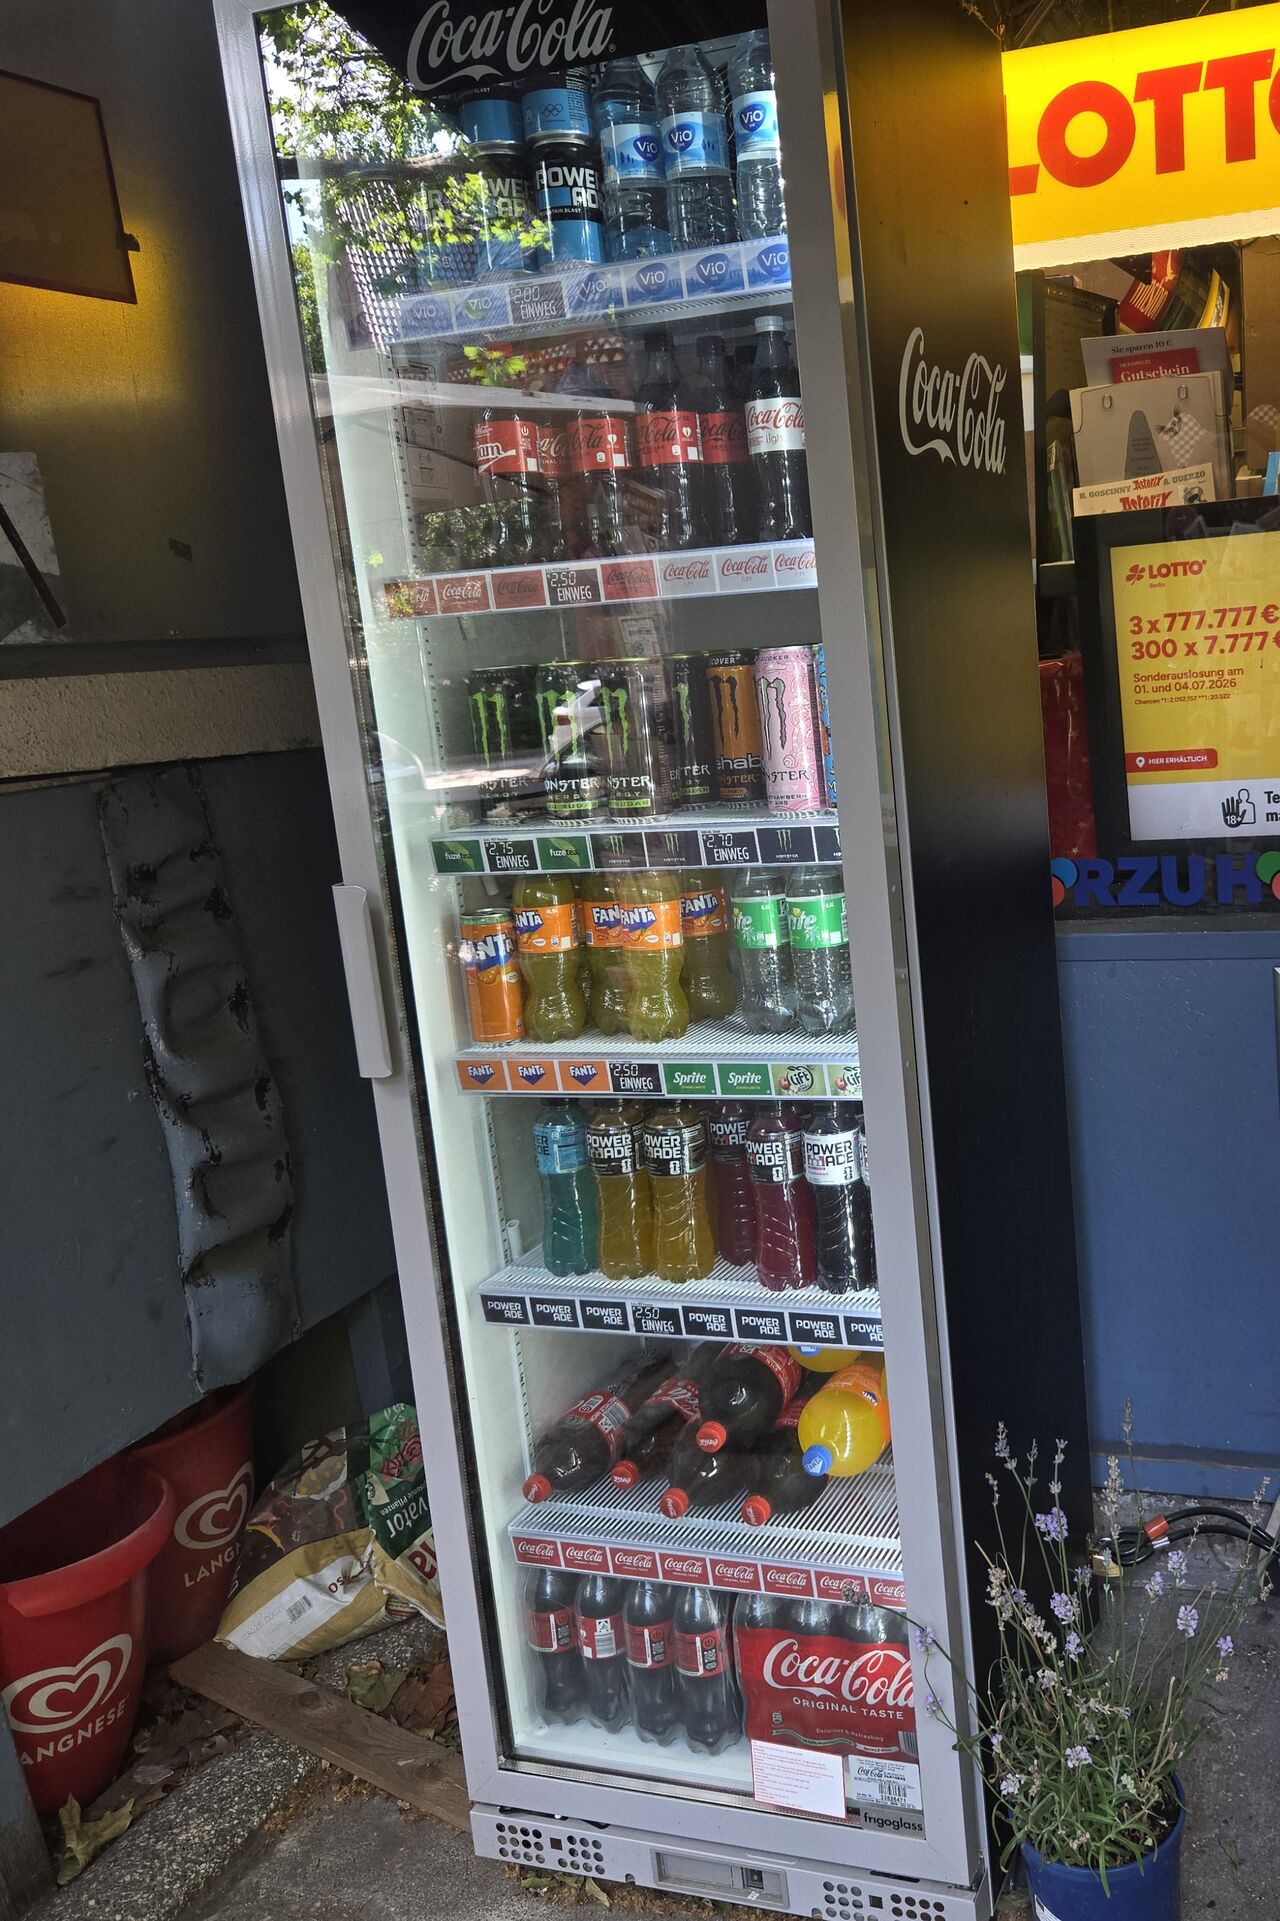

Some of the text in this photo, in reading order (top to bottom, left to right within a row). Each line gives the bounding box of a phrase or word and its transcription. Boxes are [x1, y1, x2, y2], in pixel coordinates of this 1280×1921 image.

[407, 0, 614, 91] Coca-Cola
[741, 110, 763, 124] ViO
[1004, 48, 1280, 196] OTT
[670, 130, 693, 144] ViO
[635, 140, 658, 154] ViO
[536, 166, 599, 191] POWE
[762, 252, 788, 267] ViO
[699, 261, 727, 276] ViO
[638, 270, 666, 286] ViO
[520, 301, 557, 320] EINWEG
[1120, 364, 1190, 383] Gutschein
[898, 326, 1008, 474] Coca-Cola
[766, 434, 786, 446] ligh
[1088, 485, 1132, 499] GOSCINNY
[1132, 475, 1165, 492] Asterix
[1172, 471, 1206, 484] UDERZO
[1119, 490, 1174, 512] Asterix
[721, 554, 771, 578] Coca-Cola
[774, 550, 816, 573] Coca-Col
[663, 559, 711, 582] Coca-Cola
[1148, 560, 1204, 580] LOTTO
[442, 579, 483, 601] Coca-Cola
[1149, 582, 1166, 590] Berlin
[557, 585, 592, 603] EINWEG
[1128, 603, 1280, 636] 3 x 777.777 €
[1130, 637, 1178, 661] 300
[1183, 641, 1199, 657] x
[1203, 630, 1270, 656] 7.777
[1133, 666, 1244, 684] Sonderauslosung am
[1133, 678, 1237, 695] 01. und 04.07.2026
[1134, 697, 1161, 706] Chancen
[1148, 754, 1208, 766] HIER ERHÄLTLICH
[1225, 814, 1242, 825] 18+
[496, 854, 530, 869] EINWEG
[714, 846, 750, 863] EINWEG
[621, 905, 657, 926] FANTA
[467, 1064, 496, 1076] FANTA
[517, 1064, 546, 1077] FANTA
[569, 1064, 598, 1077] FANTA
[620, 1076, 654, 1090] EINWEG
[673, 1071, 707, 1086] Sprite
[727, 1072, 763, 1087] Sprite
[710, 1121, 750, 1136] POWE
[586, 1134, 632, 1147] POWER
[806, 1140, 854, 1156] POWER
[603, 1147, 633, 1159] ADE
[652, 1147, 682, 1159] ADE
[756, 1154, 785, 1166] ADE
[824, 1151, 854, 1167] ADE
[487, 1300, 522, 1312] POWER
[536, 1303, 572, 1315] POWER
[586, 1306, 622, 1318] POWER
[504, 1310, 525, 1320] ADE
[553, 1312, 574, 1323] ADE
[603, 1315, 625, 1326] ADE
[688, 1312, 727, 1324] POWER
[741, 1315, 780, 1328] POWER
[642, 1319, 676, 1334] EINWEG
[706, 1322, 728, 1333] ADE
[759, 1326, 782, 1336] ADE
[795, 1319, 835, 1331] POWER
[814, 1329, 837, 1340] ADE
[861, 1390, 878, 1407] FANTA
[379, 1495, 409, 1517] Pflanzen
[518, 1541, 555, 1557] Coca-Cola
[566, 1546, 604, 1562] Coca-Cola
[615, 1552, 653, 1568] Coca-Cola
[664, 1557, 704, 1574] Coca-Cola
[715, 1563, 755, 1580] Coca-Cola
[767, 1569, 808, 1586] Coca-Cola
[763, 1638, 915, 1709] Coca-Cola
[792, 1696, 905, 1720] ORIGINAL TASTE
[857, 1766, 884, 1779] Coca-Cola
[863, 1811, 924, 1832] frigoglass
